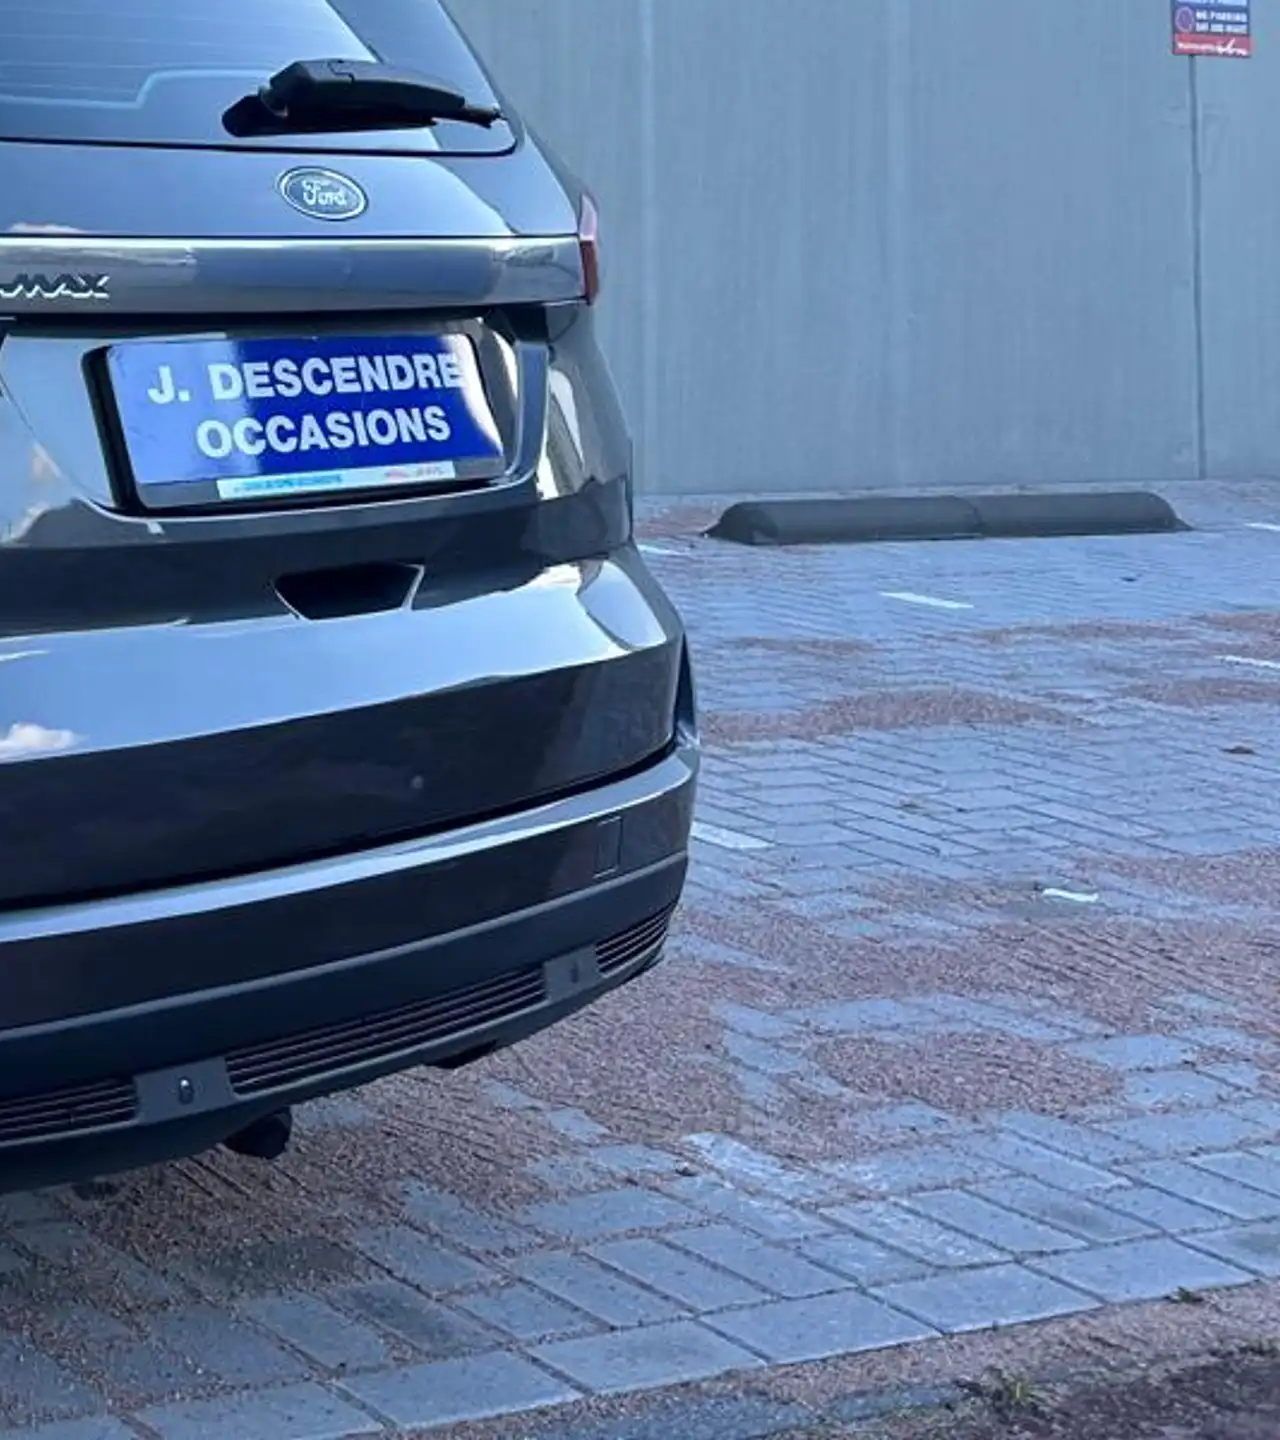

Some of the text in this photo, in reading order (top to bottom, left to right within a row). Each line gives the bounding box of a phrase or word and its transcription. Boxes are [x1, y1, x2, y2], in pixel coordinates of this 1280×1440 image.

[302, 180, 347, 206] Ford
[147, 353, 467, 404] J. DESCENDRE
[196, 406, 451, 458] OCCASIONS
